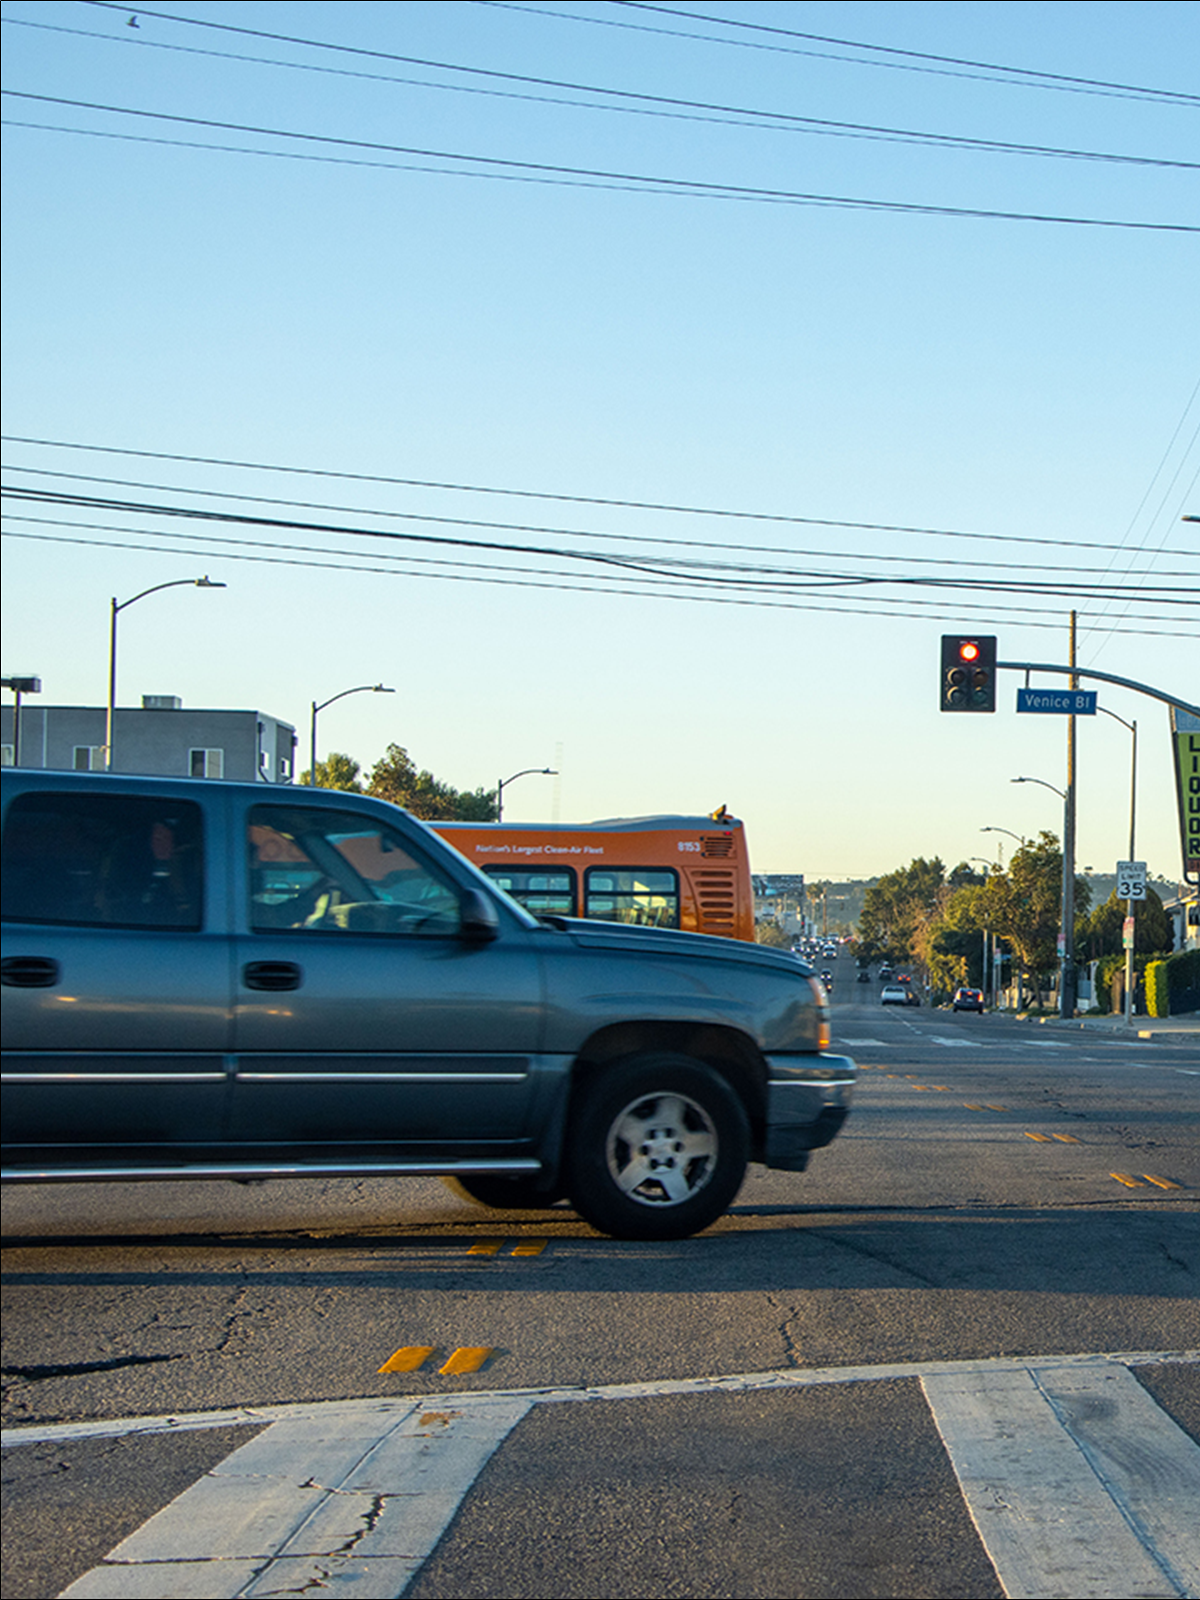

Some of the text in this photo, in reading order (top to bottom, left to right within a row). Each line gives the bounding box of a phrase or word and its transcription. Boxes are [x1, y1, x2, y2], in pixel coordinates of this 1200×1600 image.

[1025, 695, 1070, 709] Venice
[677, 842, 700, 852] 8153
[1120, 882, 1143, 896] 35
